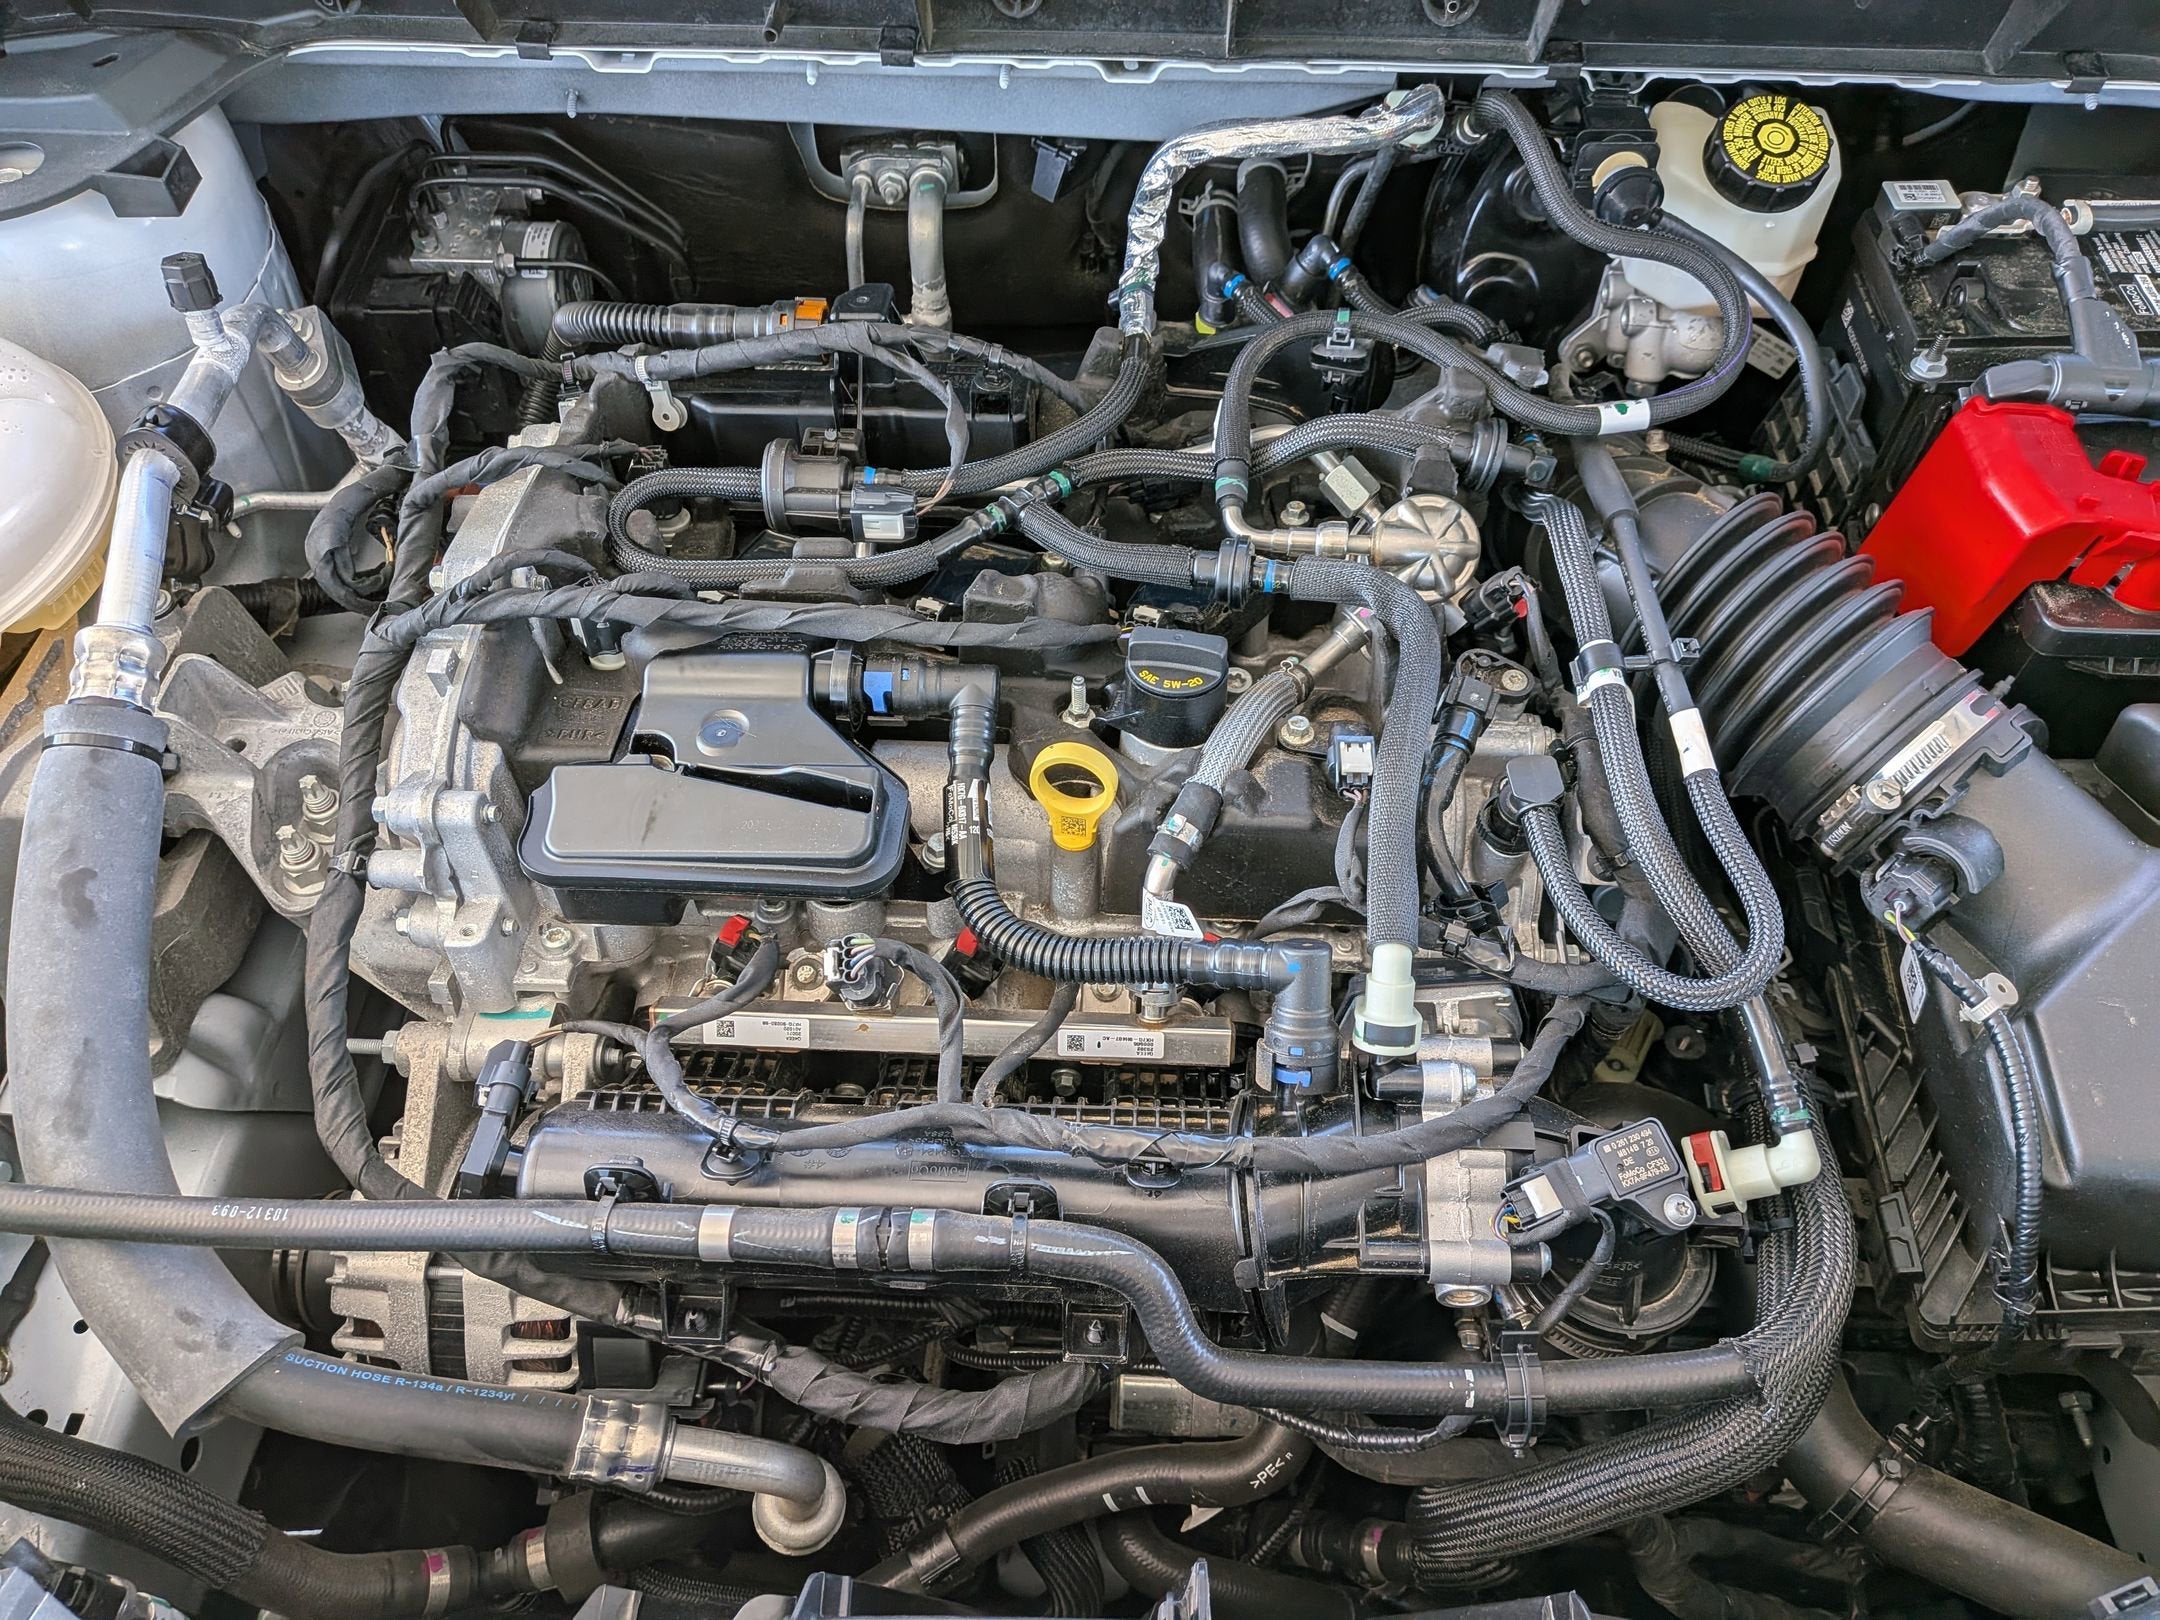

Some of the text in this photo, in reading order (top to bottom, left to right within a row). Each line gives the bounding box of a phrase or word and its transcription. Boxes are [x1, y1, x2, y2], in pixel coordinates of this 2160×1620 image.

[2126, 286, 2150, 314] FoMoCo
[1139, 670, 1203, 688] SAE 5W-20
[1616, 1137, 1629, 1148] 261
[1628, 1133, 1641, 1143] 230
[1622, 1156, 1635, 1167] DE
[911, 1165, 968, 1177] FoMoCo
[1617, 1166, 1645, 1180] FoMoCo
[211, 1204, 289, 1221] 10312-093
[285, 1352, 348, 1376] SUCTION
[350, 1369, 392, 1385] HOSE
[394, 1377, 444, 1392] R-134a
[455, 1385, 517, 1401] R-1234yf
